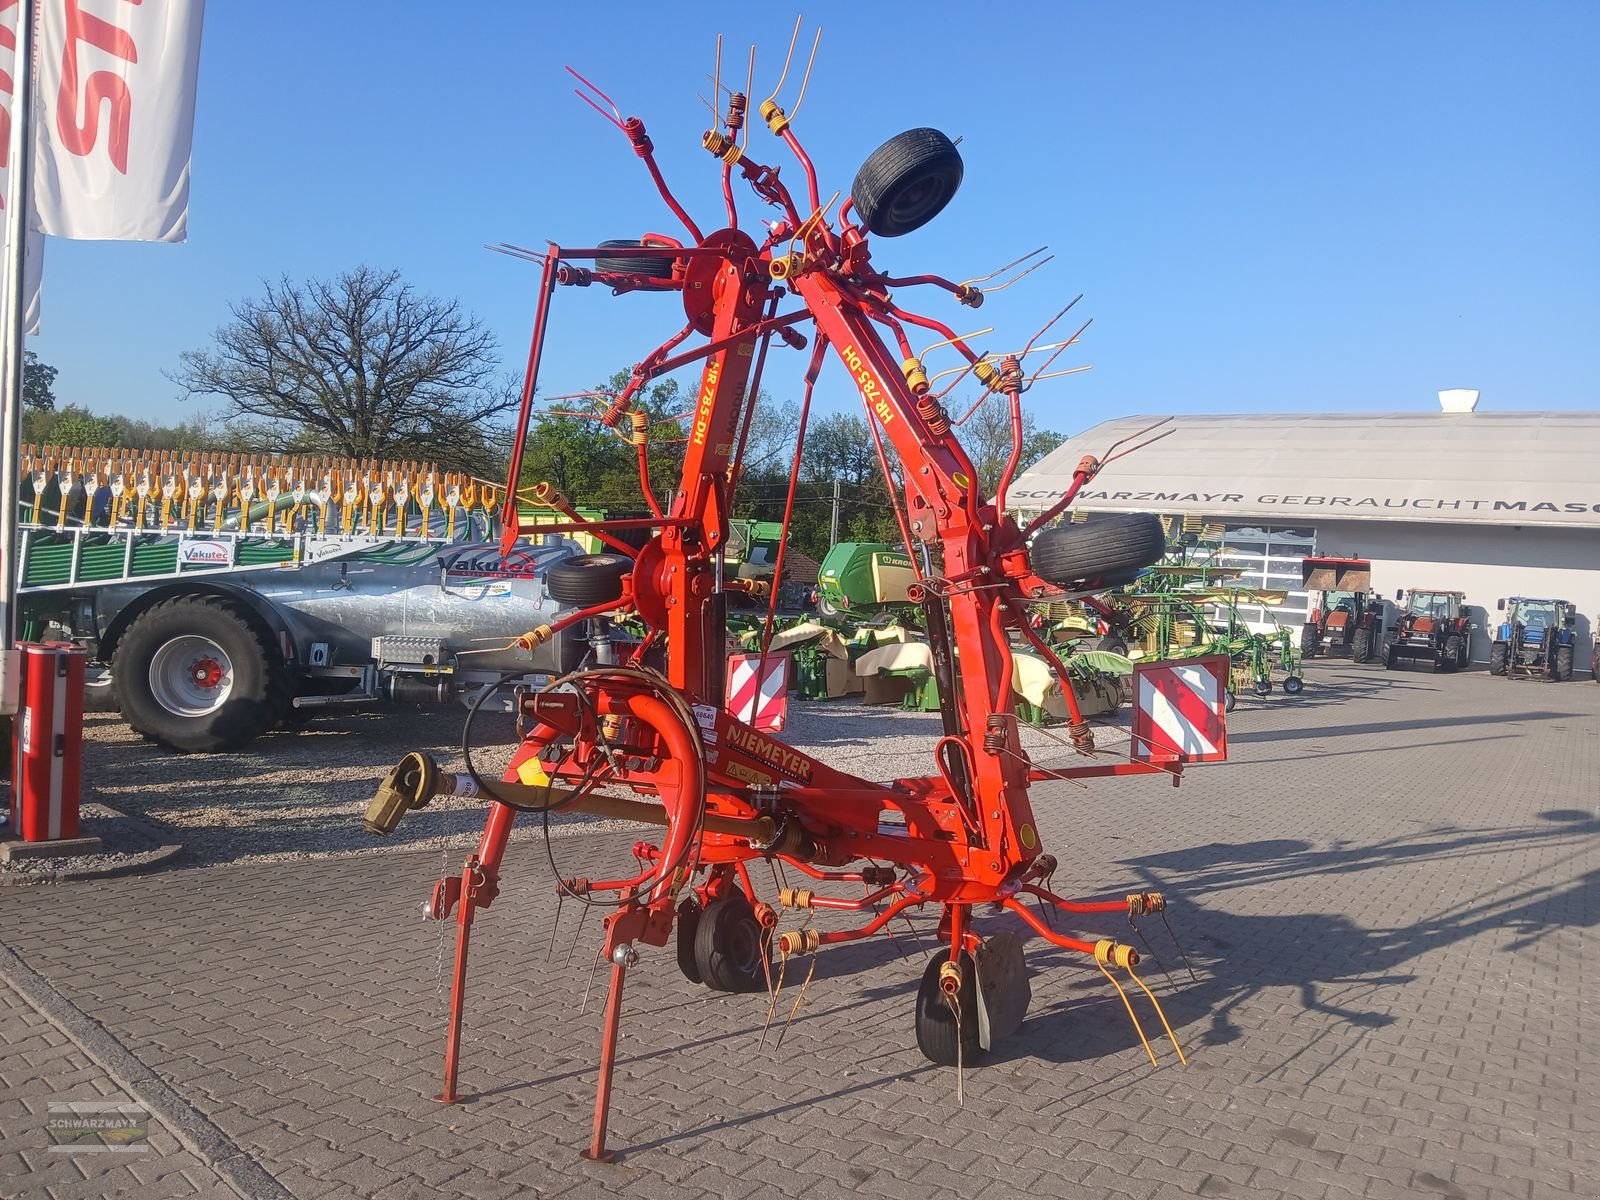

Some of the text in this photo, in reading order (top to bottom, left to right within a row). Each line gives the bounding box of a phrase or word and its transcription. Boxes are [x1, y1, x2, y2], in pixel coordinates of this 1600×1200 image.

[56, 0, 142, 175] ST
[842, 344, 894, 425] HR 785-DH
[693, 361, 720, 445] HR 785-DH
[1011, 490, 1244, 503] SCHWARZMAYR
[184, 547, 229, 561] Vakutec
[316, 546, 343, 558] Vakutec
[891, 558, 913, 567] KRON
[437, 553, 536, 574] Vakutec
[726, 724, 811, 777] NIEMEYER
